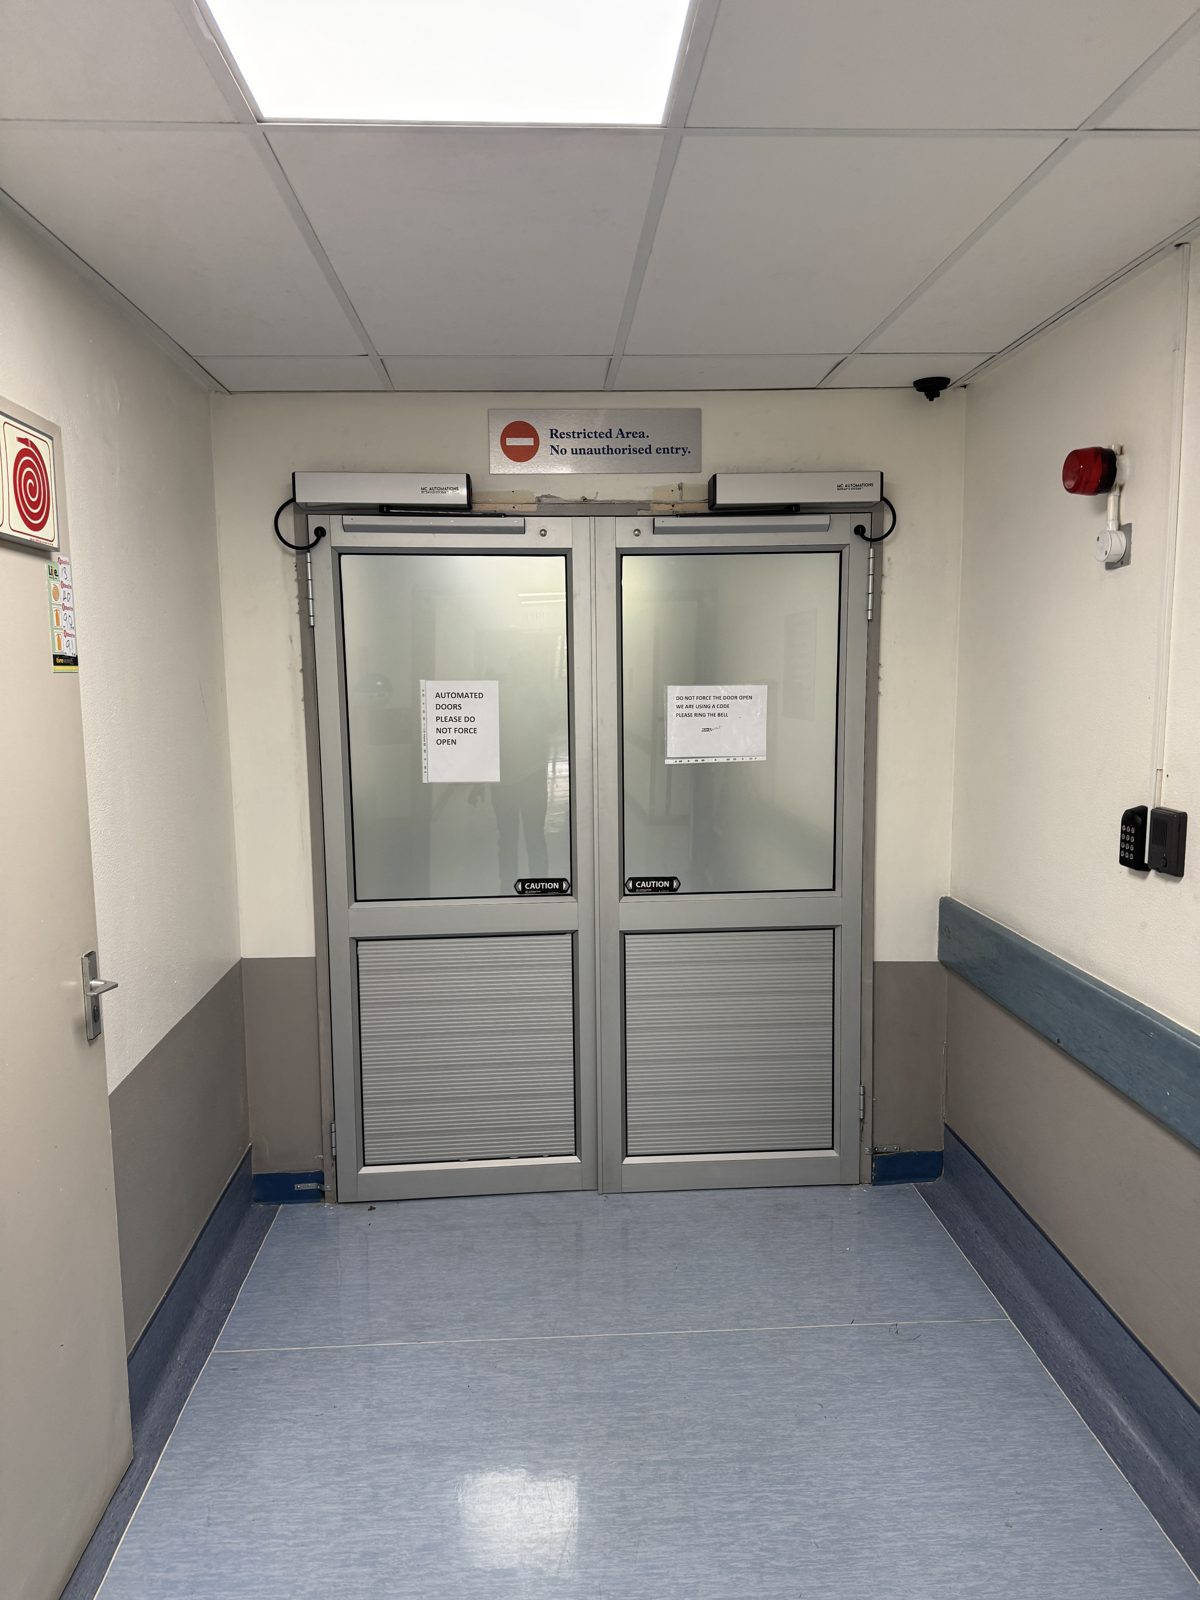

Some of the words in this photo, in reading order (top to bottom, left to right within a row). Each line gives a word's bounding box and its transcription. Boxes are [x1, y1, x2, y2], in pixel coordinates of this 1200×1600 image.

[549, 428, 613, 439] Restricted
[615, 428, 650, 439] Area.
[549, 444, 568, 456] No
[570, 444, 652, 456] unauthorised
[655, 445, 692, 457] entry.
[524, 882, 560, 890] CAUTION
[635, 880, 670, 888] CAUTION
